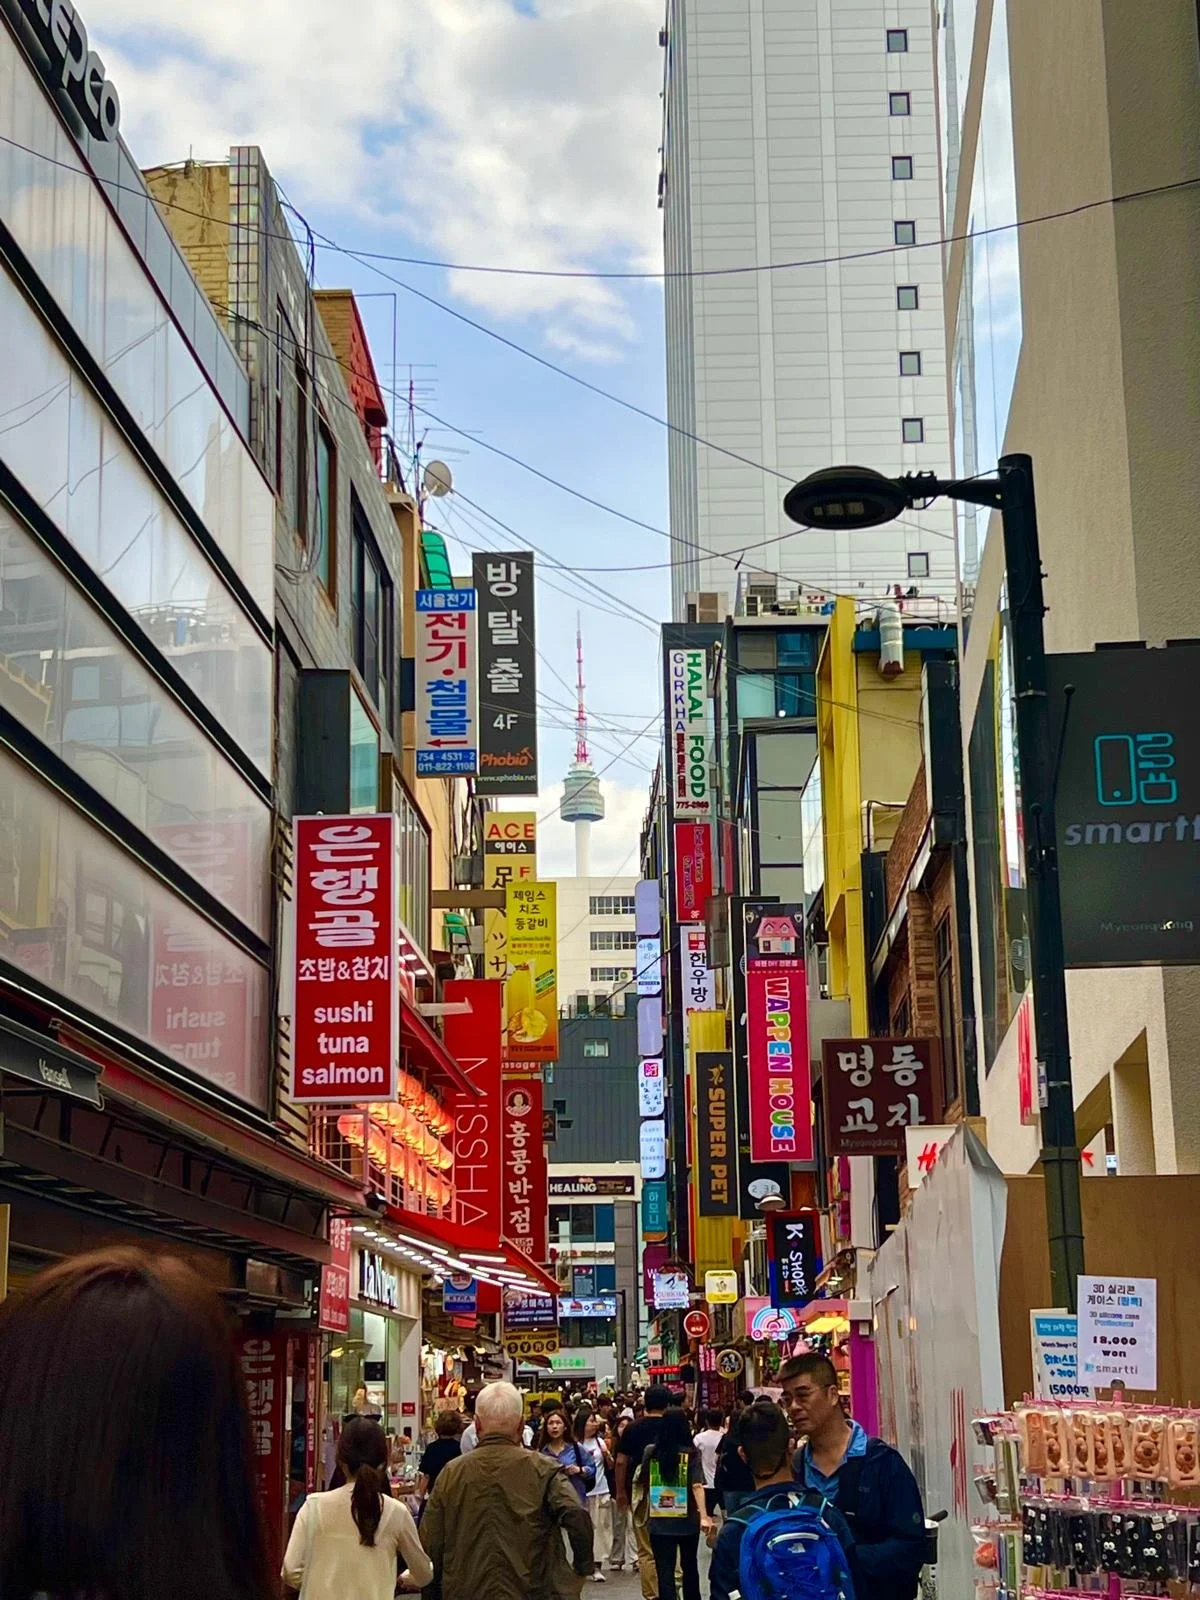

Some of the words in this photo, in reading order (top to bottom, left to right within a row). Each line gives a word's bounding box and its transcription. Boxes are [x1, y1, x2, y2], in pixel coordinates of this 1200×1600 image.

[419, 592, 473, 608] 서울전기
[487, 561, 523, 694] 방탈출
[673, 653, 686, 732] GURKHA
[686, 653, 703, 724] HALAL
[493, 714, 519, 730] 4F
[689, 735, 706, 798] FOOD
[487, 822, 534, 839] ACE
[494, 841, 528, 854] 에이스
[308, 825, 381, 948] 은행골
[515, 917, 548, 931] 등갈비
[519, 905, 541, 915] 치즈
[298, 955, 389, 983] 초밥&참치
[689, 952, 708, 1003] 한우방
[313, 1000, 374, 1024] sushi
[764, 976, 793, 1073] WAPPEN
[317, 1032, 370, 1055] tuna
[301, 1062, 384, 1086] salmon
[836, 1044, 924, 1087] 명동
[708, 1087, 727, 1159] SUPER
[768, 1077, 796, 1153] HOUSE
[839, 1093, 927, 1133] 교자
[455, 1057, 489, 1227] MISSHA
[505, 1120, 533, 1234] 홍콩반점
[549, 1182, 597, 1193] HEALING
[710, 1163, 728, 1205] PET
[785, 1223, 804, 1240] K
[1095, 1364, 1139, 1375] smartti
[1101, 1349, 1127, 1358] won
